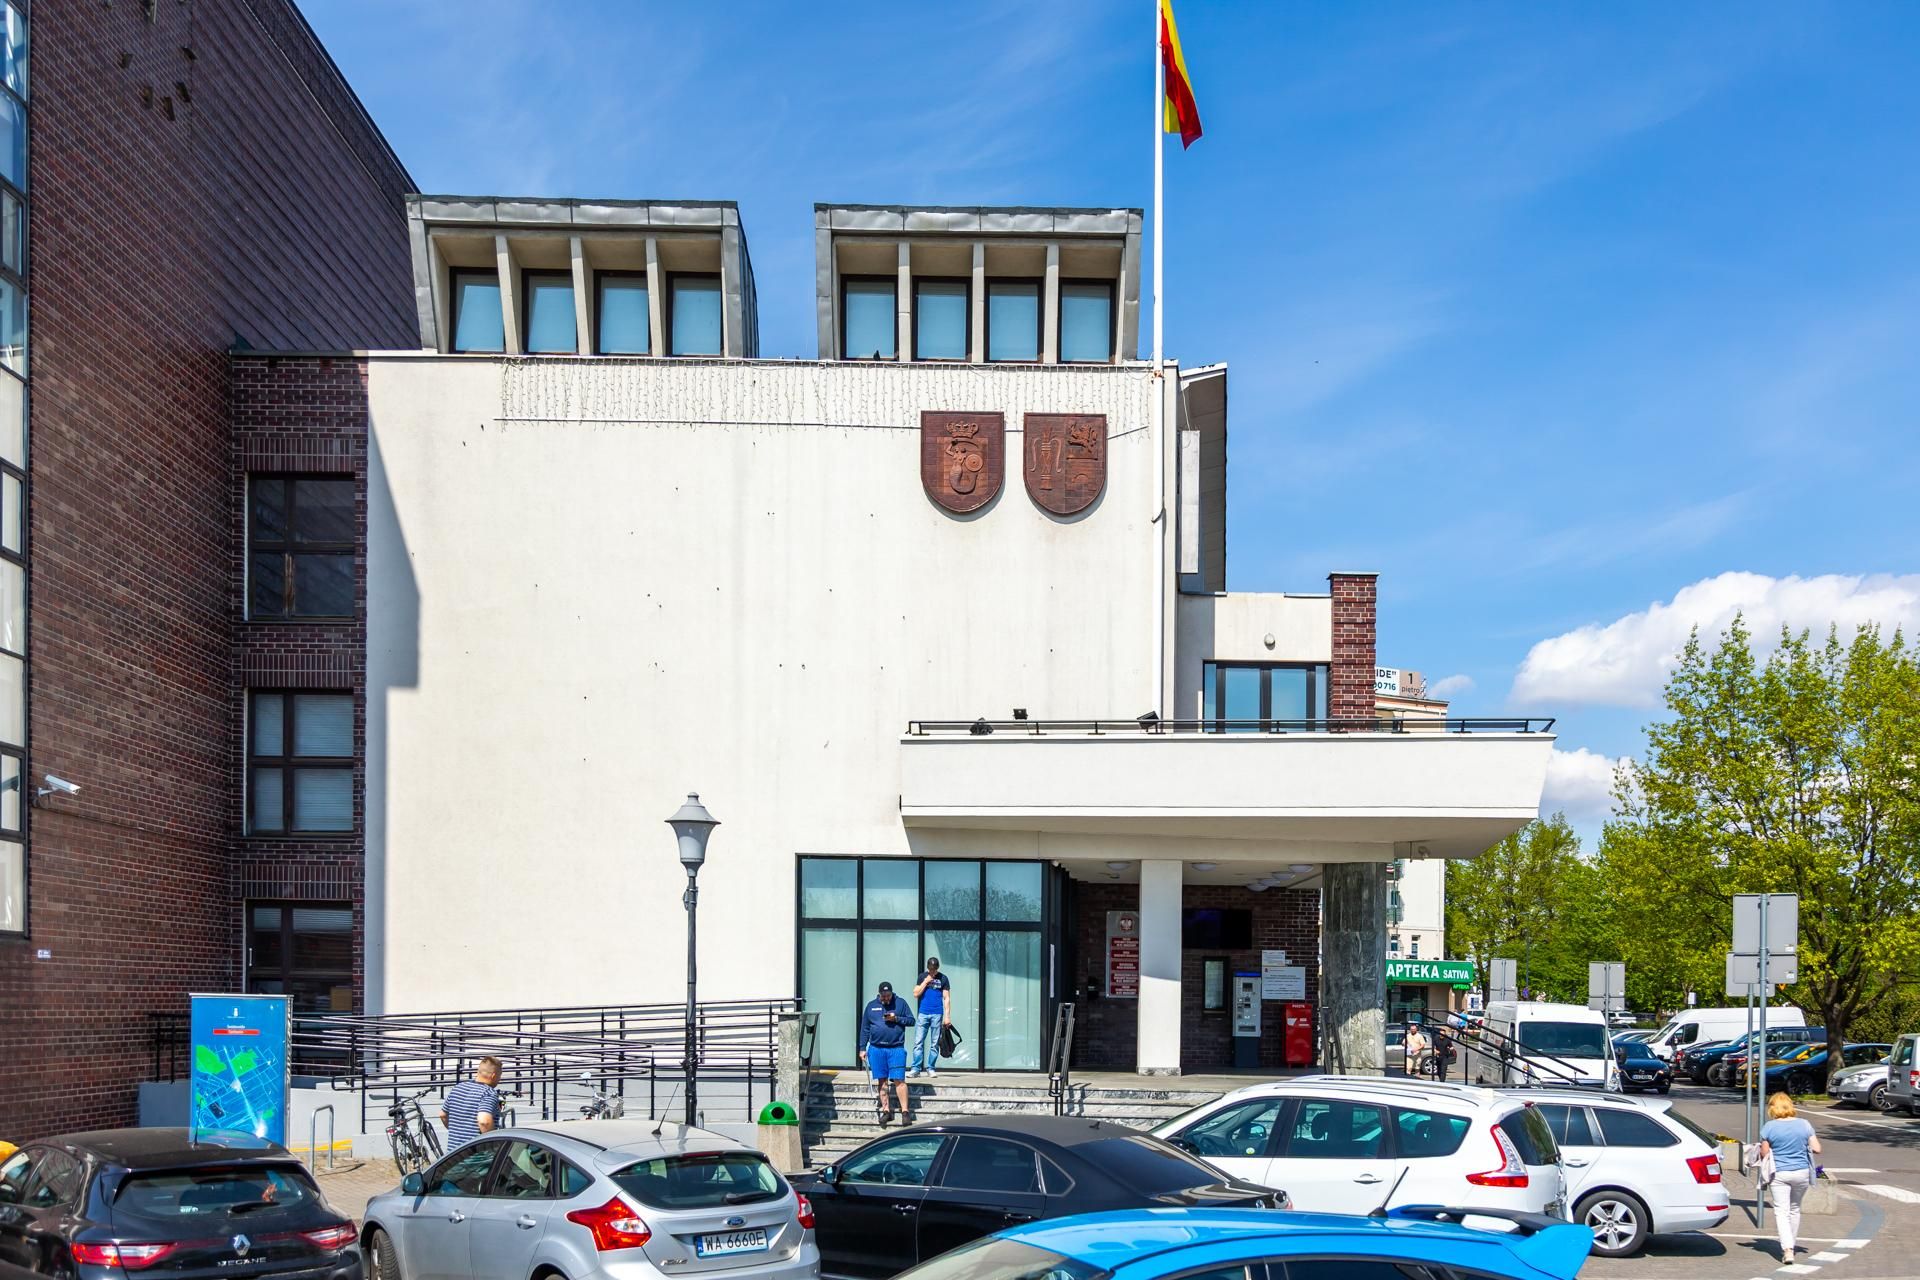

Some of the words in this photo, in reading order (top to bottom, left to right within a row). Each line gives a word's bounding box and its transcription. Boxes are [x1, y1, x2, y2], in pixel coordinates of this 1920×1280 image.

[1408, 672, 1413, 685] 1
[1386, 963, 1440, 979] APTEKA
[1443, 969, 1470, 980] SATIVA
[705, 1235, 723, 1251] WA
